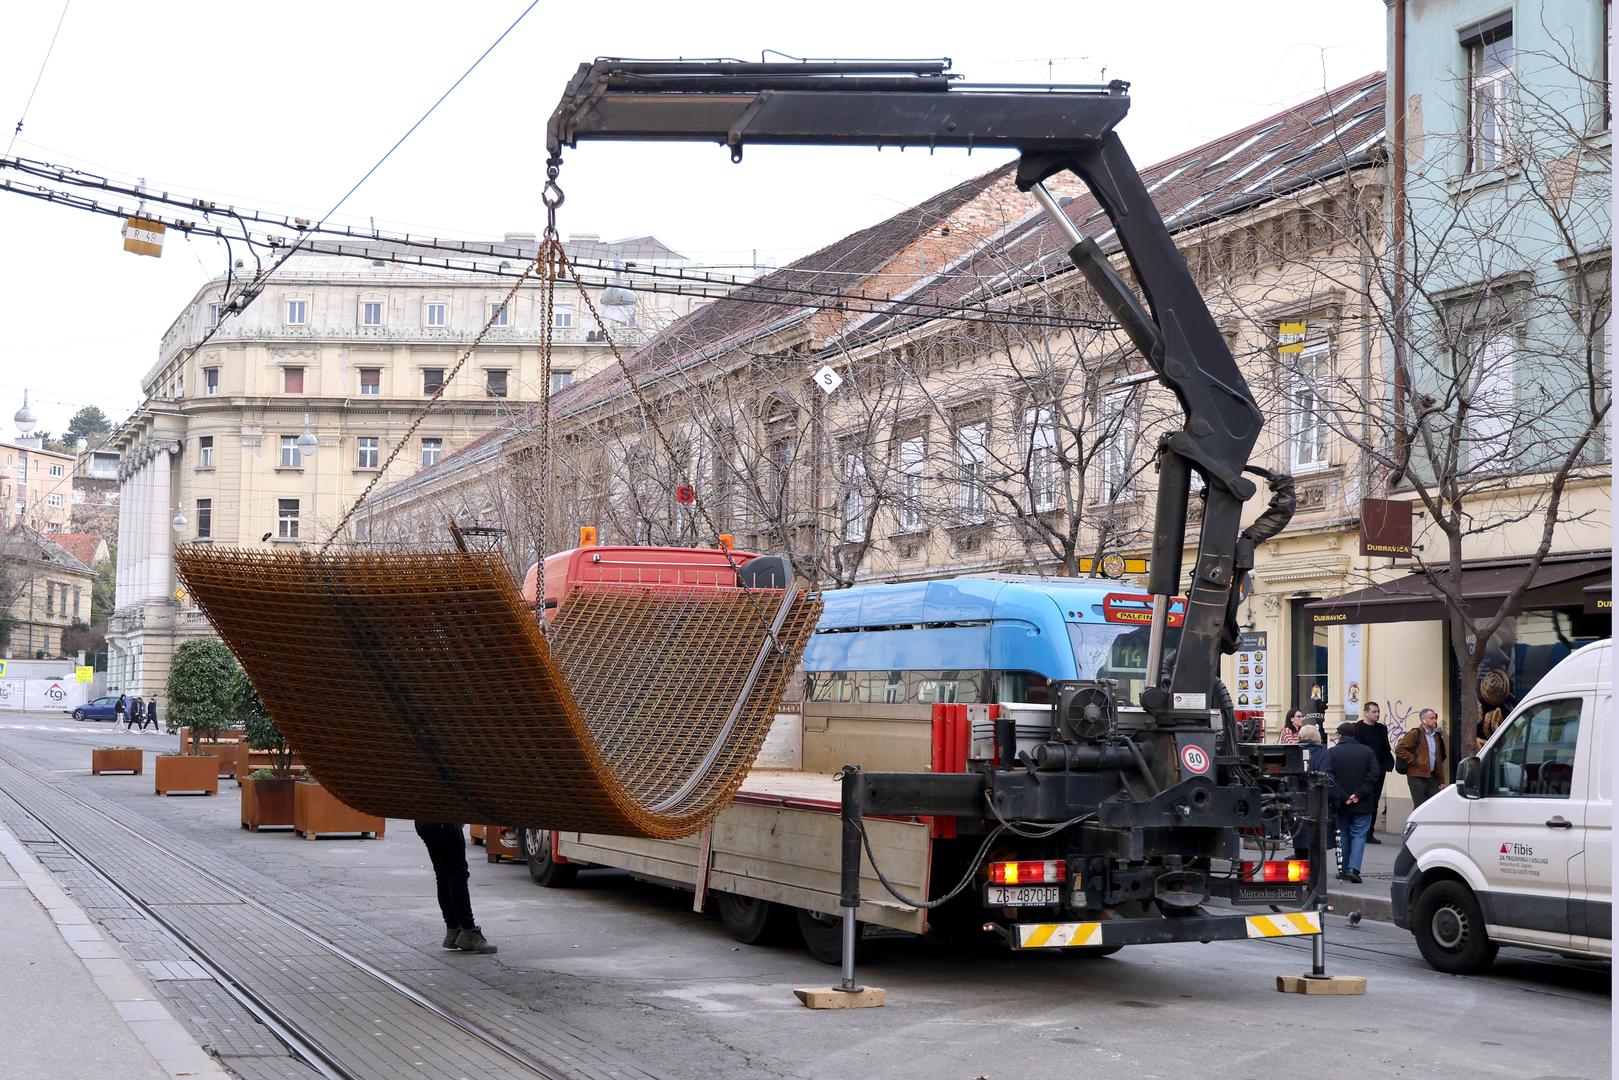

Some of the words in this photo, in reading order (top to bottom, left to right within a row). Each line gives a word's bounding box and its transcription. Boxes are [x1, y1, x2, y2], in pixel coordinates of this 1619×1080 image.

[824, 373, 833, 385] S
[680, 487, 691, 501] S
[1367, 544, 1409, 553] DUBRAVICA
[1120, 612, 1173, 622] PALFIN
[1313, 614, 1347, 622] DUBRAVICA
[1121, 648, 1142, 667] 14
[50, 688, 63, 702] tg
[1188, 752, 1202, 764] 80
[1514, 843, 1533, 856] fibis
[996, 888, 1010, 903] ZG
[1239, 889, 1297, 899] Mercedes-Benz
